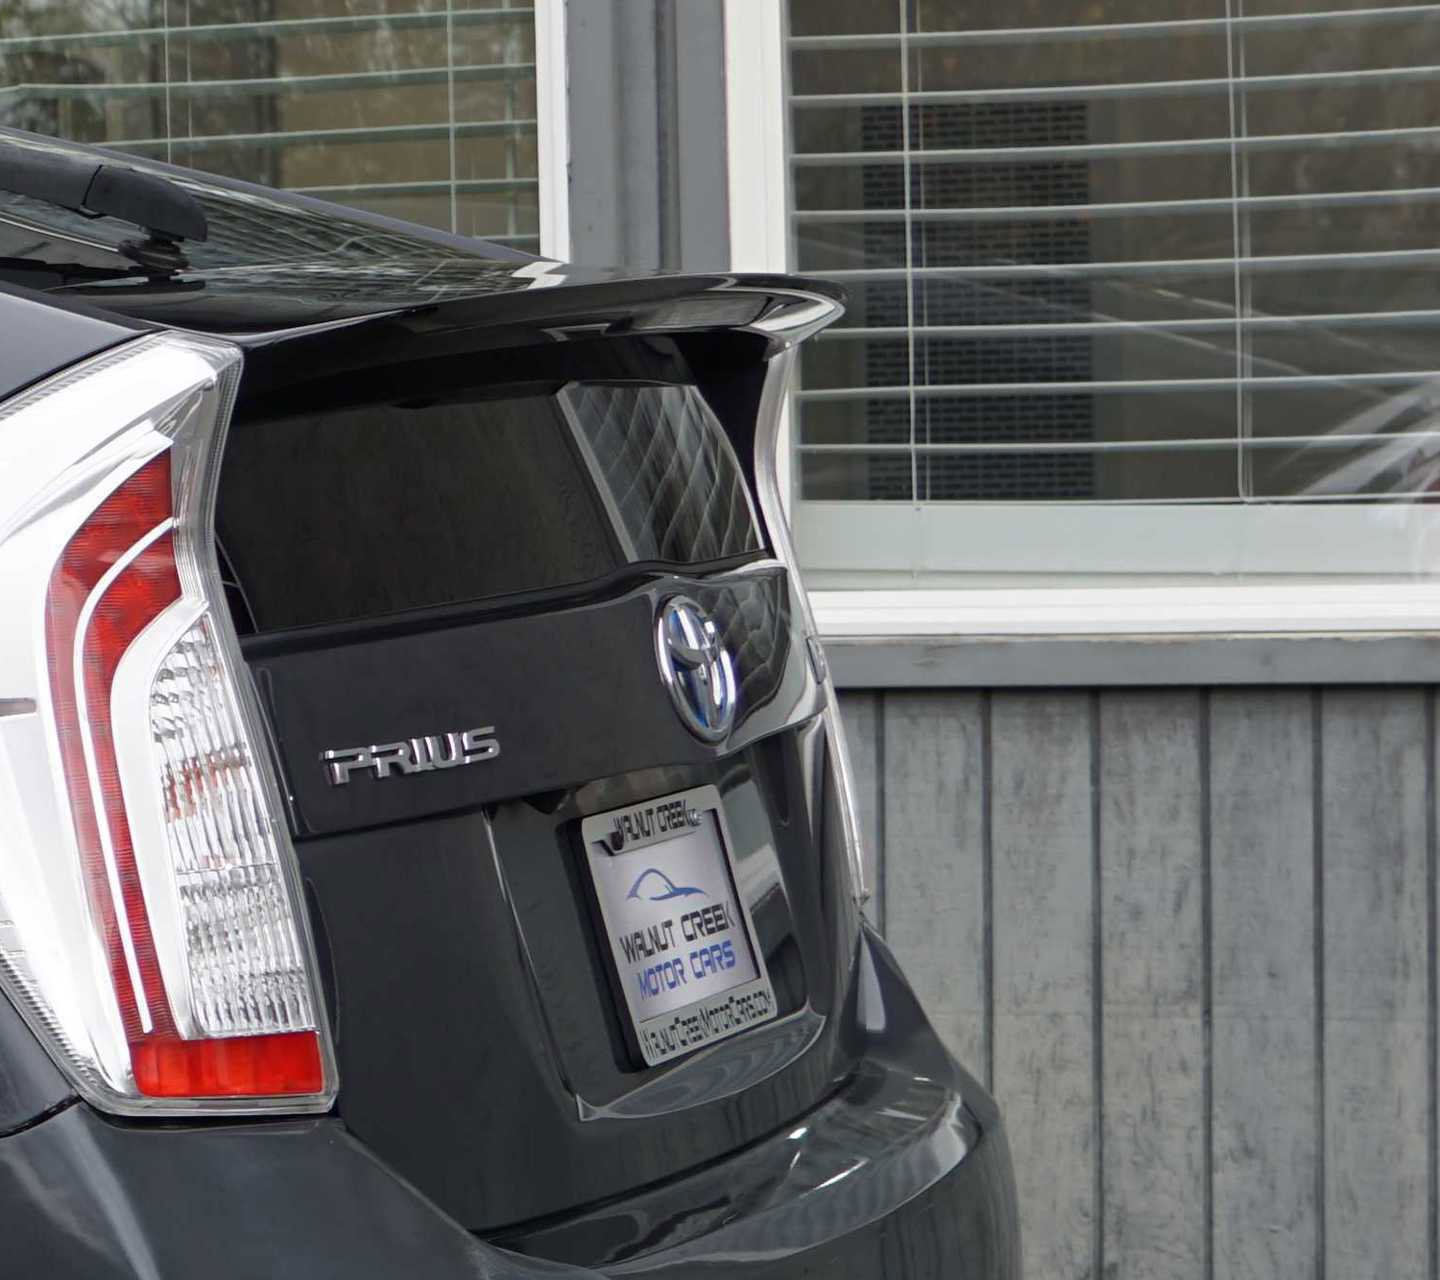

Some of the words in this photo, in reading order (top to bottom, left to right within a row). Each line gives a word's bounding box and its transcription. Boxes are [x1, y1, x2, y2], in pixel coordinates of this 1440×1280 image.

[318, 725, 501, 784] PRIUS
[620, 920, 673, 964] WALNUT
[680, 901, 736, 943] CREEK
[637, 960, 688, 1000] MOTOR
[689, 939, 737, 979] CARS
